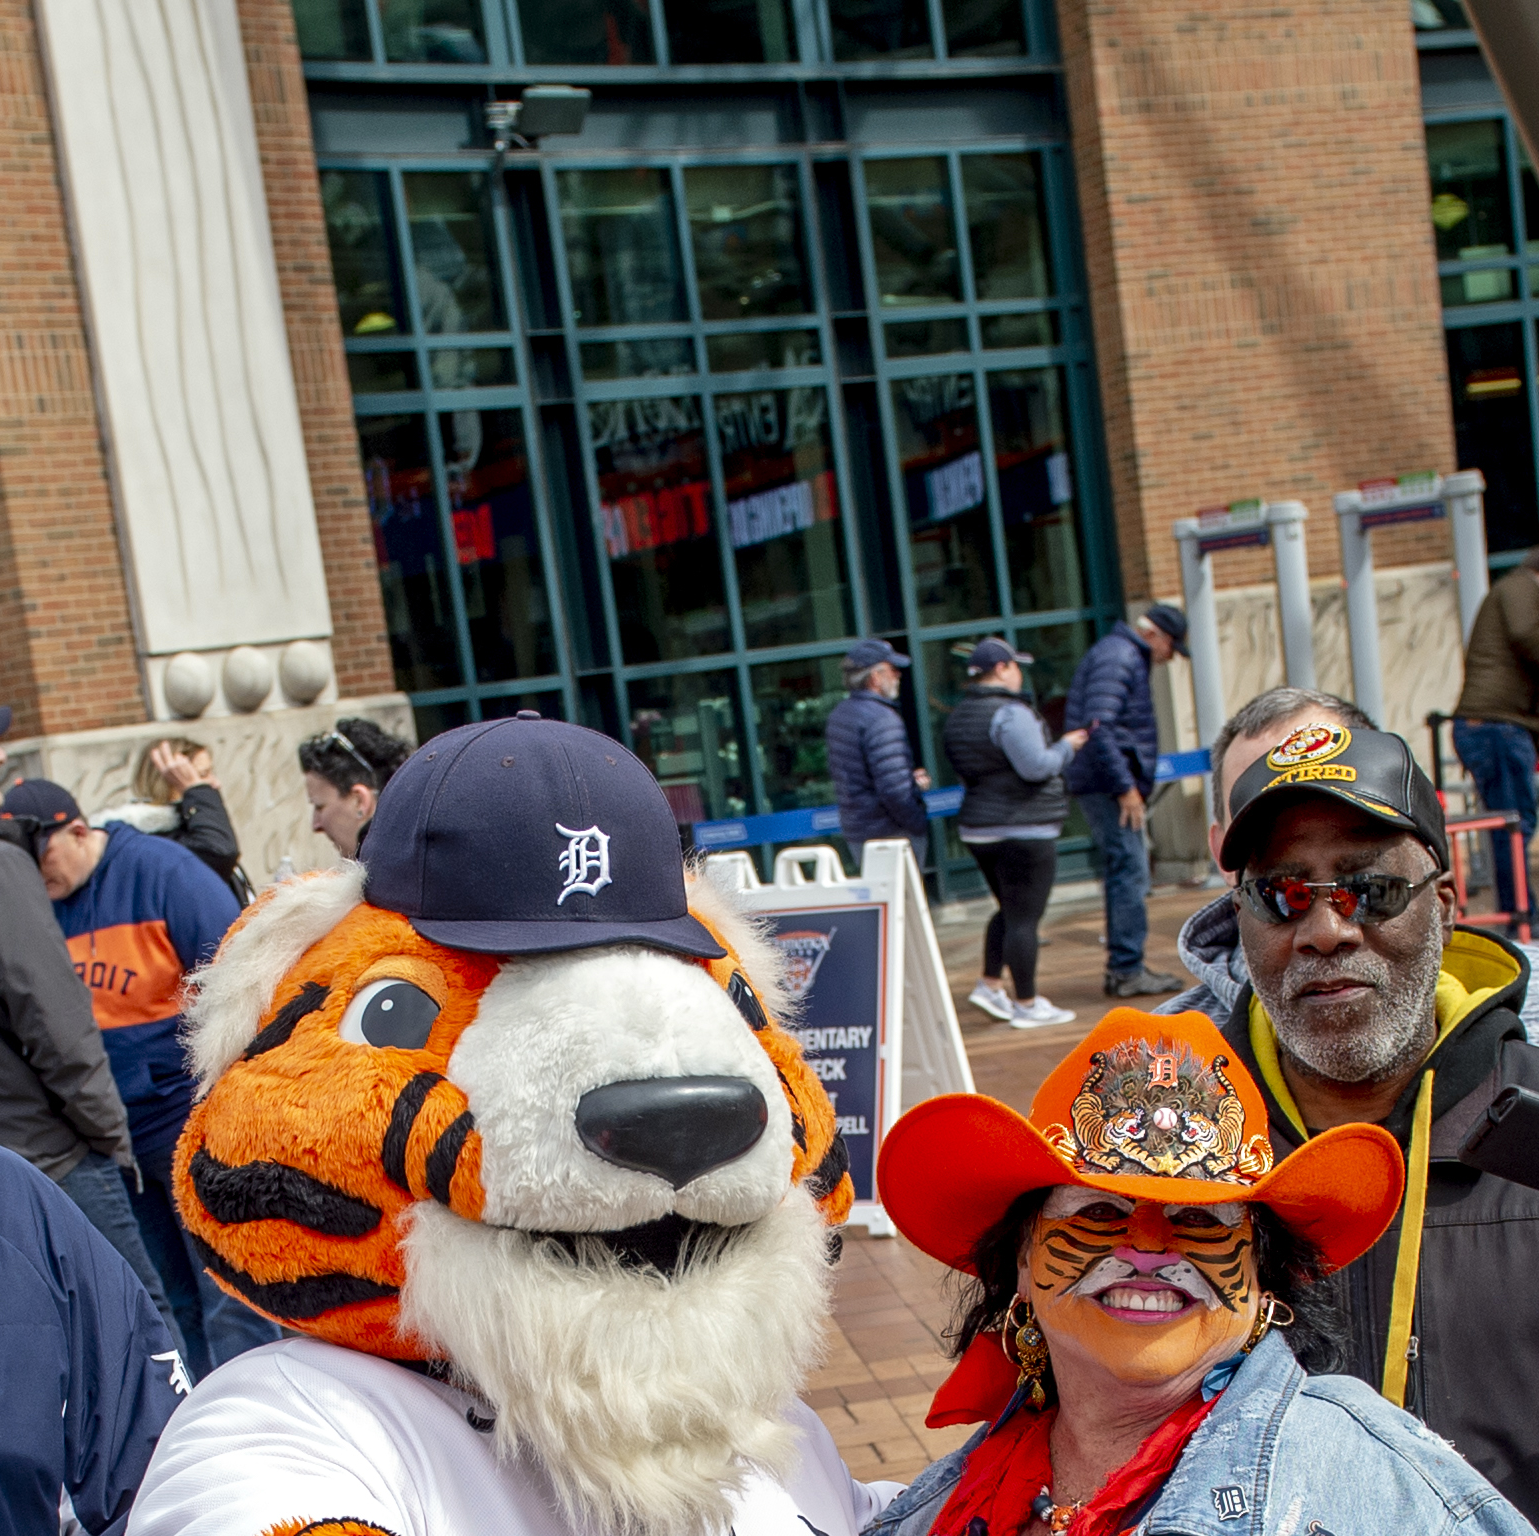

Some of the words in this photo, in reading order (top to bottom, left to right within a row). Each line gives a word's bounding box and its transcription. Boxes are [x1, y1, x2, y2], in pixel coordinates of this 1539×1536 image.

[1262, 764, 1357, 790] TIRED
[73, 961, 137, 996] ROIT
[808, 1057, 847, 1081] ECK
